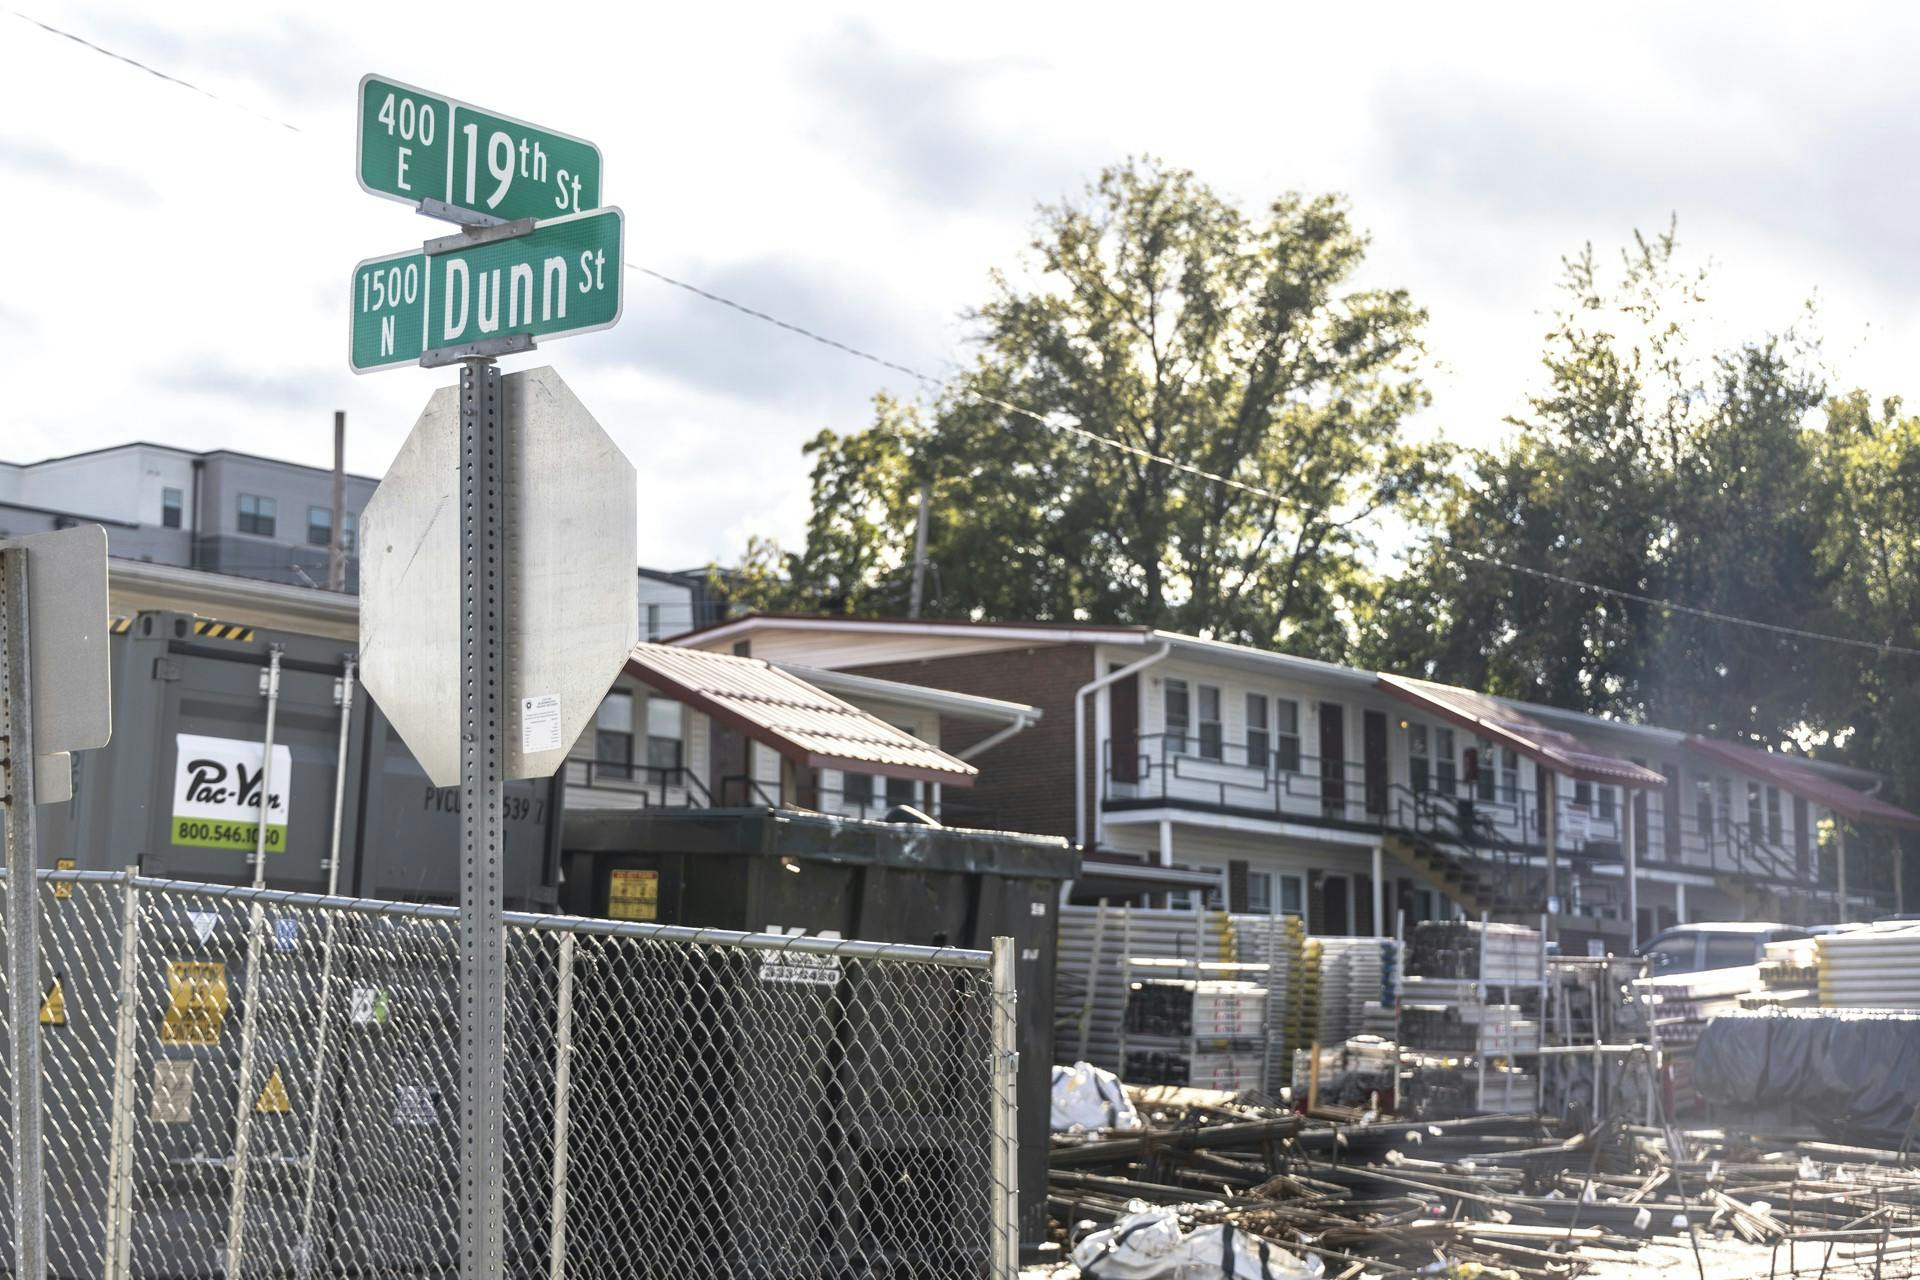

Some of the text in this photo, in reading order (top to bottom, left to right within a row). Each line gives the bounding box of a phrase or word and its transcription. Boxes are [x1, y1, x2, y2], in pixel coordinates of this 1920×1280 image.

[378, 92, 435, 147] 400
[397, 146, 413, 191] E
[463, 122, 582, 213] 19th St
[362, 262, 418, 313] 1500
[444, 247, 605, 341] Dunn St
[380, 315, 395, 357] N
[186, 758, 281, 809] Pac-Van
